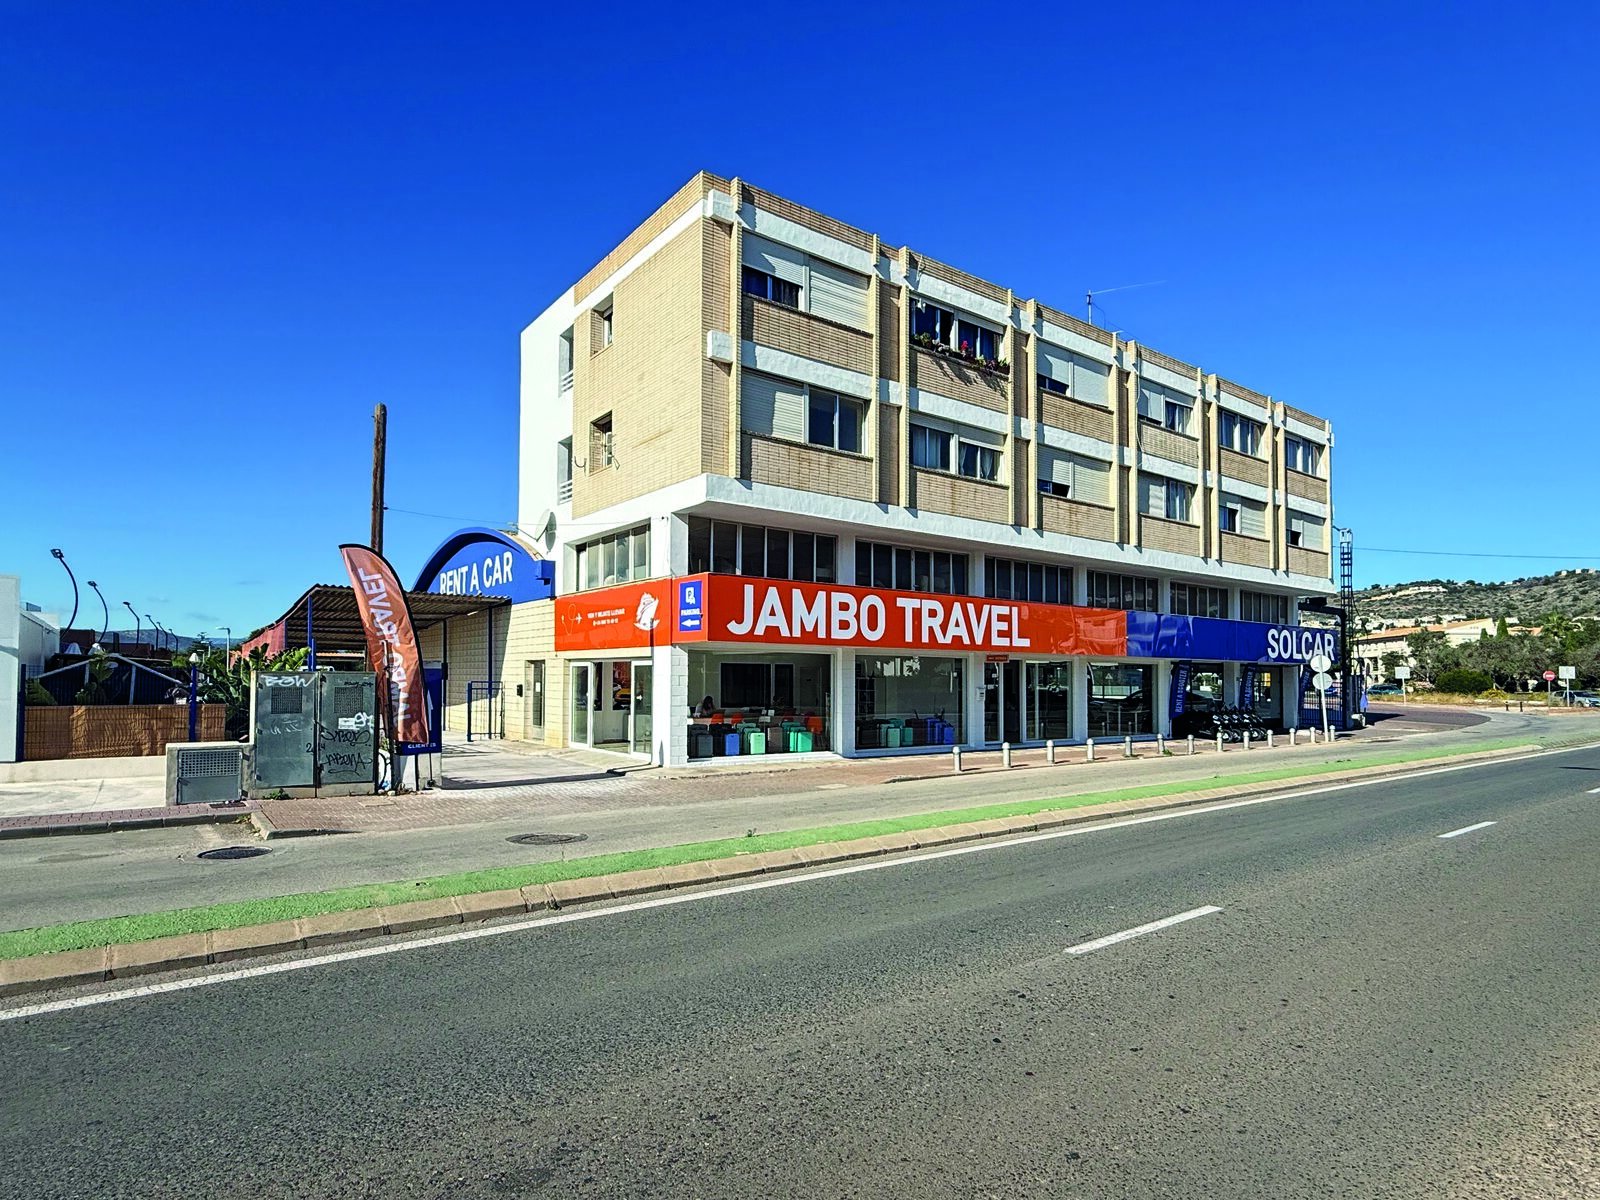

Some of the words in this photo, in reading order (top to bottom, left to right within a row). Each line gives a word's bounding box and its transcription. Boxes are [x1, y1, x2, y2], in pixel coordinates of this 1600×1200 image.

[439, 566, 469, 596] RENT
[469, 562, 480, 593] A
[483, 551, 513, 588] CAR
[726, 584, 886, 641] JAMBO
[896, 597, 1031, 647] TRAVEL
[1267, 628, 1335, 660] SOLCAR
